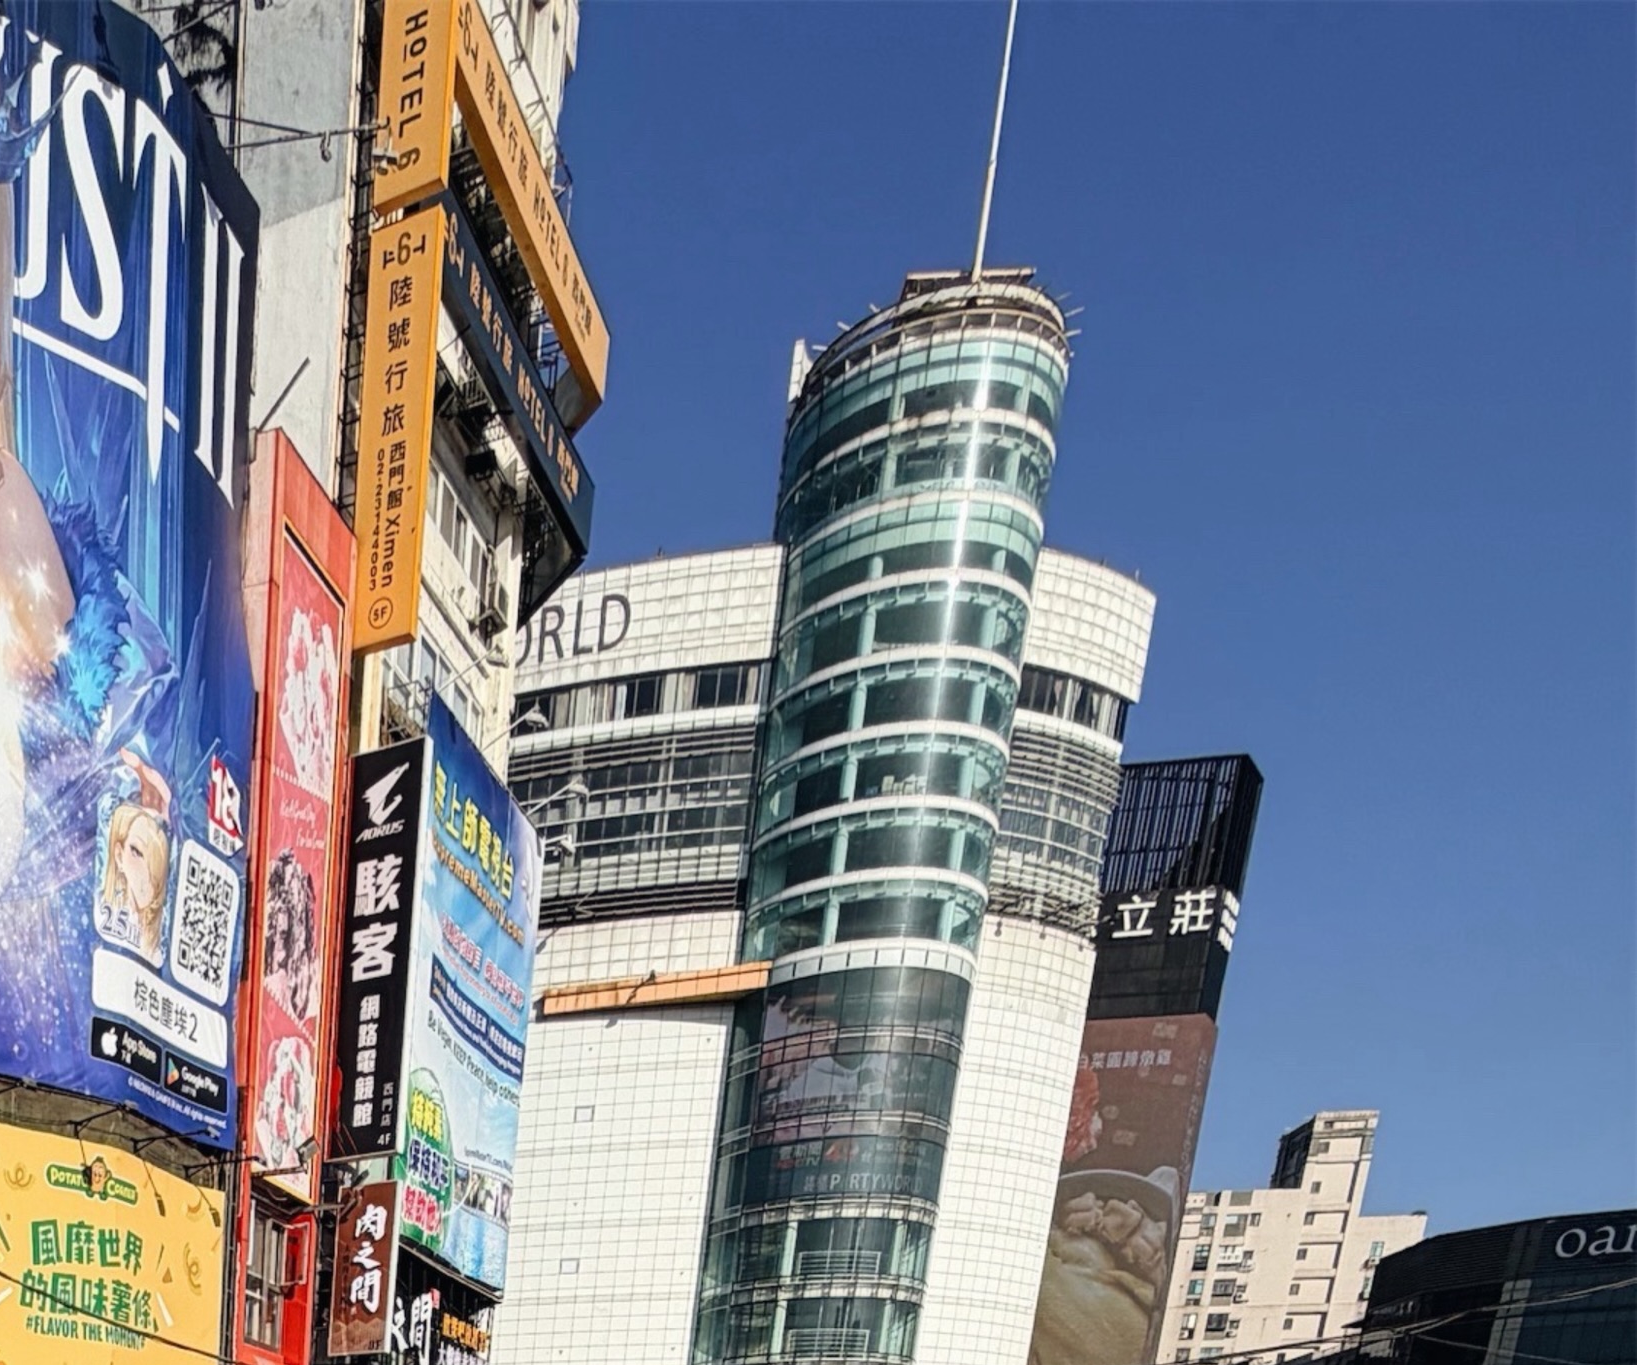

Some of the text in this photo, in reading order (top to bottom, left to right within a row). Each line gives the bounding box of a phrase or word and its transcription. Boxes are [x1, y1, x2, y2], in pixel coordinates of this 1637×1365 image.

[398, 8, 429, 139] HOTEL
[381, 275, 414, 438] 陸號行旅
[380, 440, 407, 588] 西門館 Ximen
[355, 819, 405, 843] AORUS
[352, 853, 404, 983] 駭客
[1090, 885, 1217, 939] 立莊
[31, 1218, 144, 1277] 風靡世界
[350, 1203, 388, 1314] 肉之間
[25, 1314, 79, 1341] #FLAVOR
[82, 1320, 103, 1343] THE
